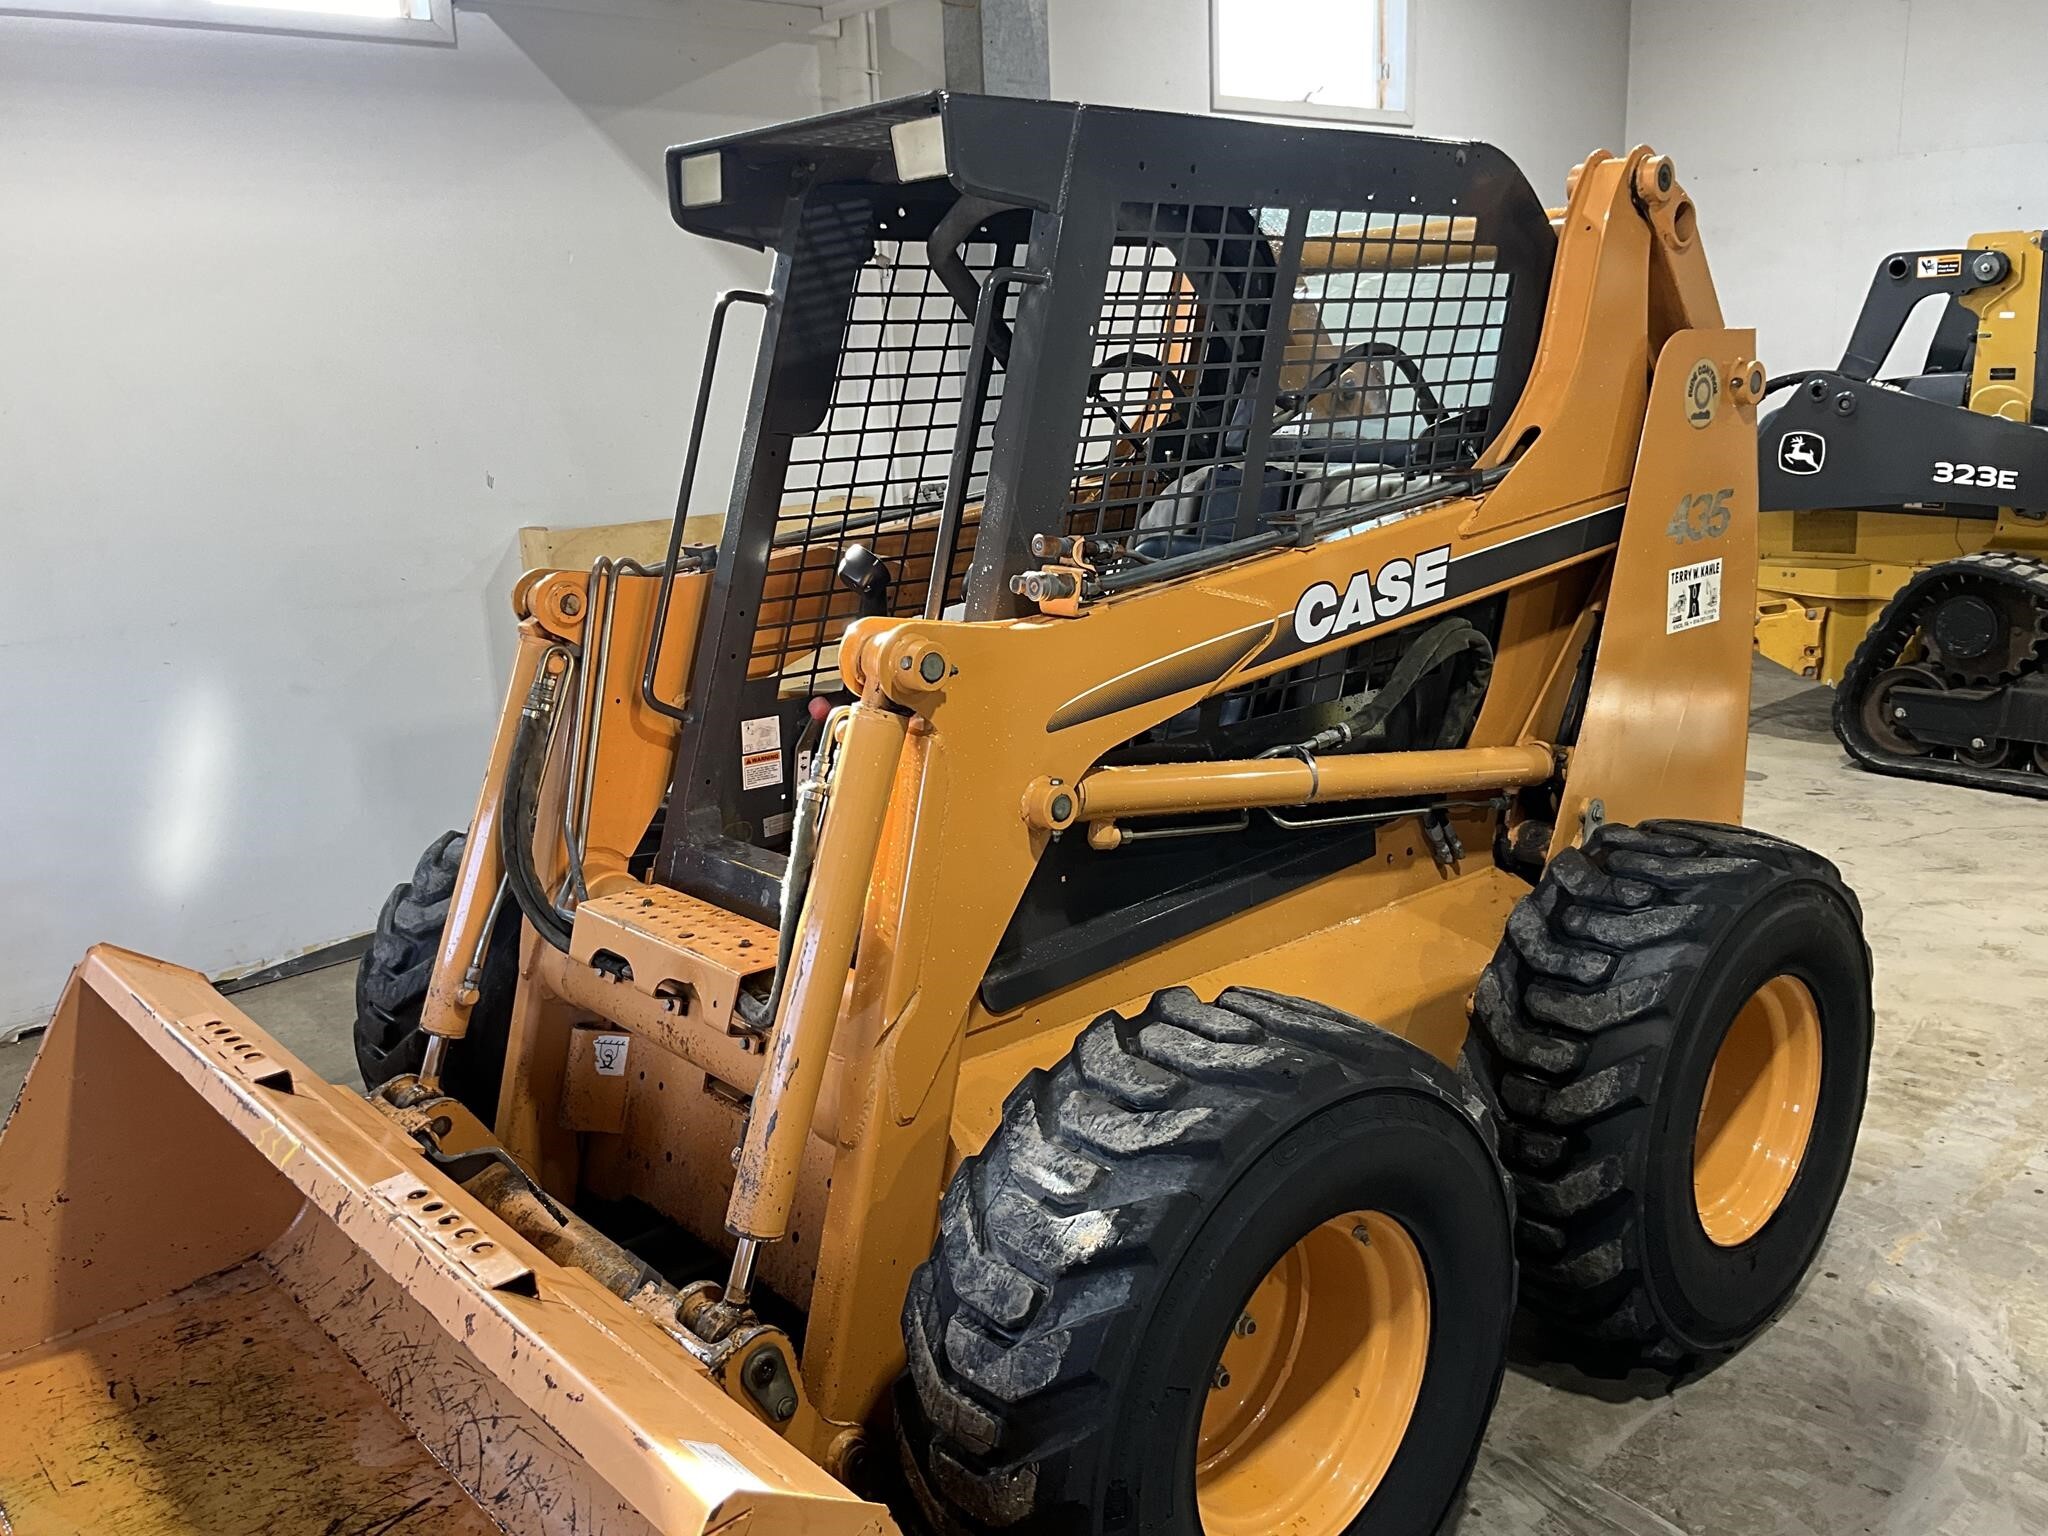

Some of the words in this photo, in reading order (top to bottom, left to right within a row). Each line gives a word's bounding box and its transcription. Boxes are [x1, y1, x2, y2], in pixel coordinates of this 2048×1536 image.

[1932, 461, 2019, 490] 323E
[1664, 488, 1734, 545] 435
[1294, 545, 1451, 644] CASE
[1671, 567, 1693, 585] TERRY
[1700, 562, 1720, 578] KAHLE
